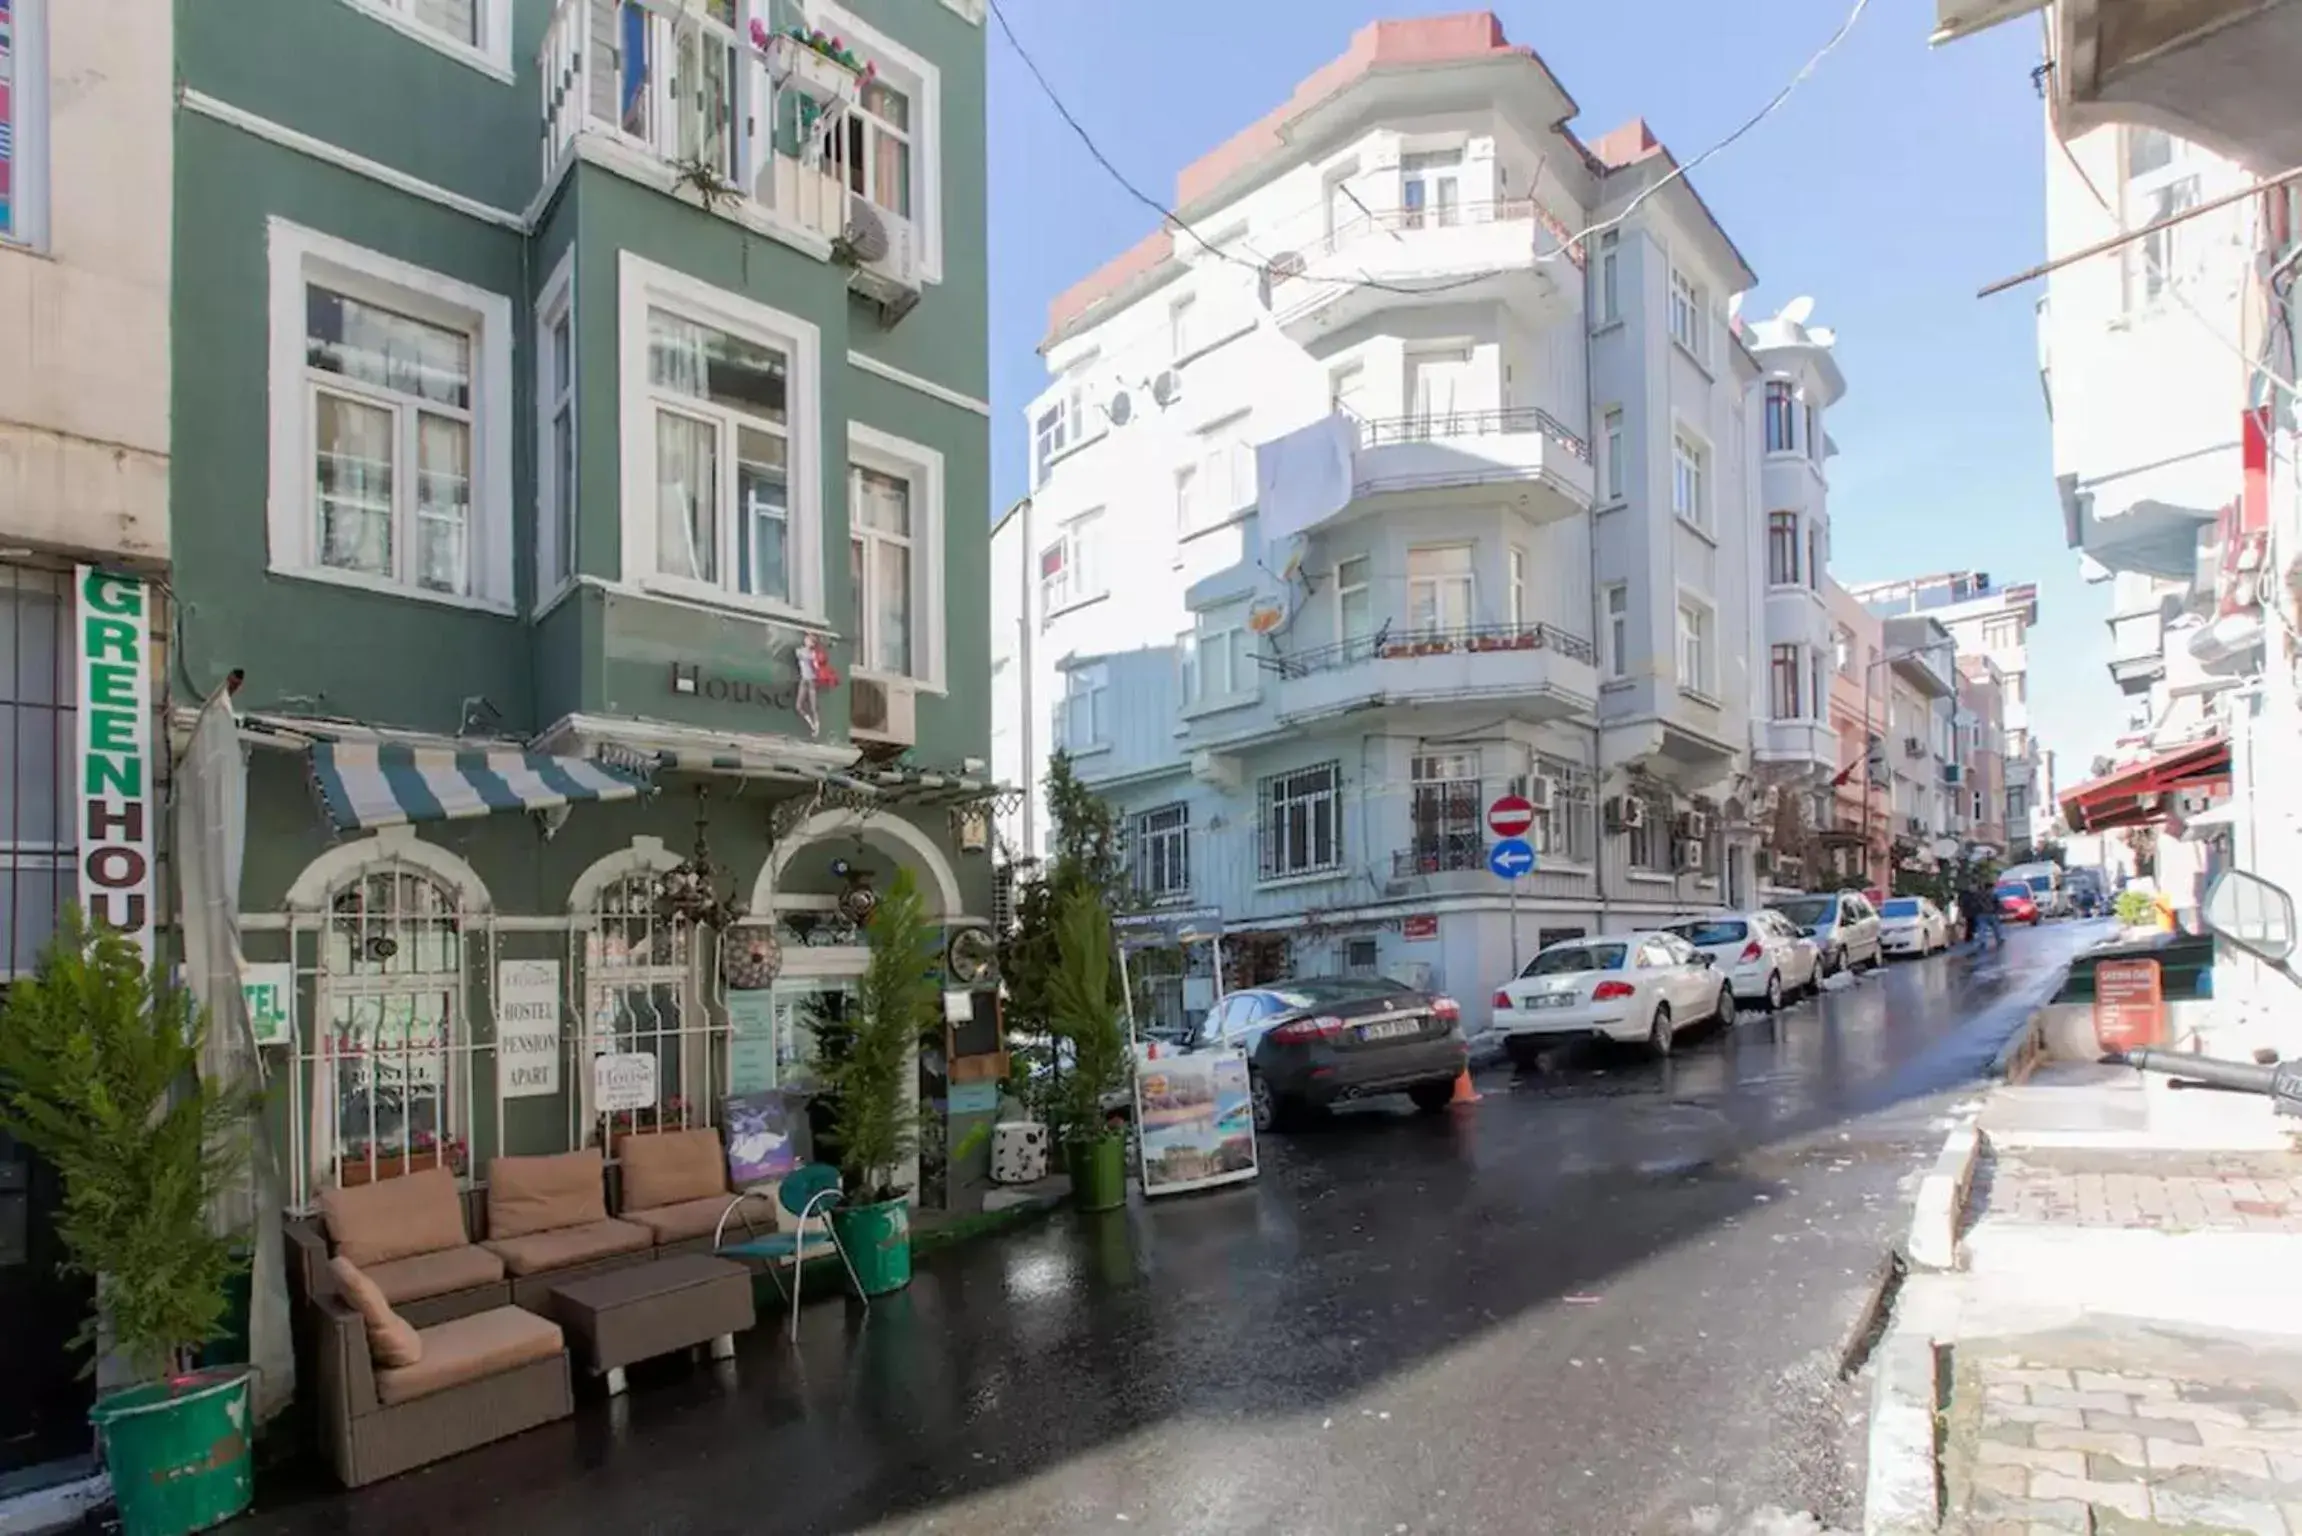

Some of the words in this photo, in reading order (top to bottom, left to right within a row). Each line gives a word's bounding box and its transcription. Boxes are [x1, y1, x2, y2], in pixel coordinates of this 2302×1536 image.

[243, 984, 286, 1022] TEL
[505, 1002, 553, 1021] HOSTEL
[503, 1033, 557, 1054] PENSION
[510, 1066, 550, 1087] APART
